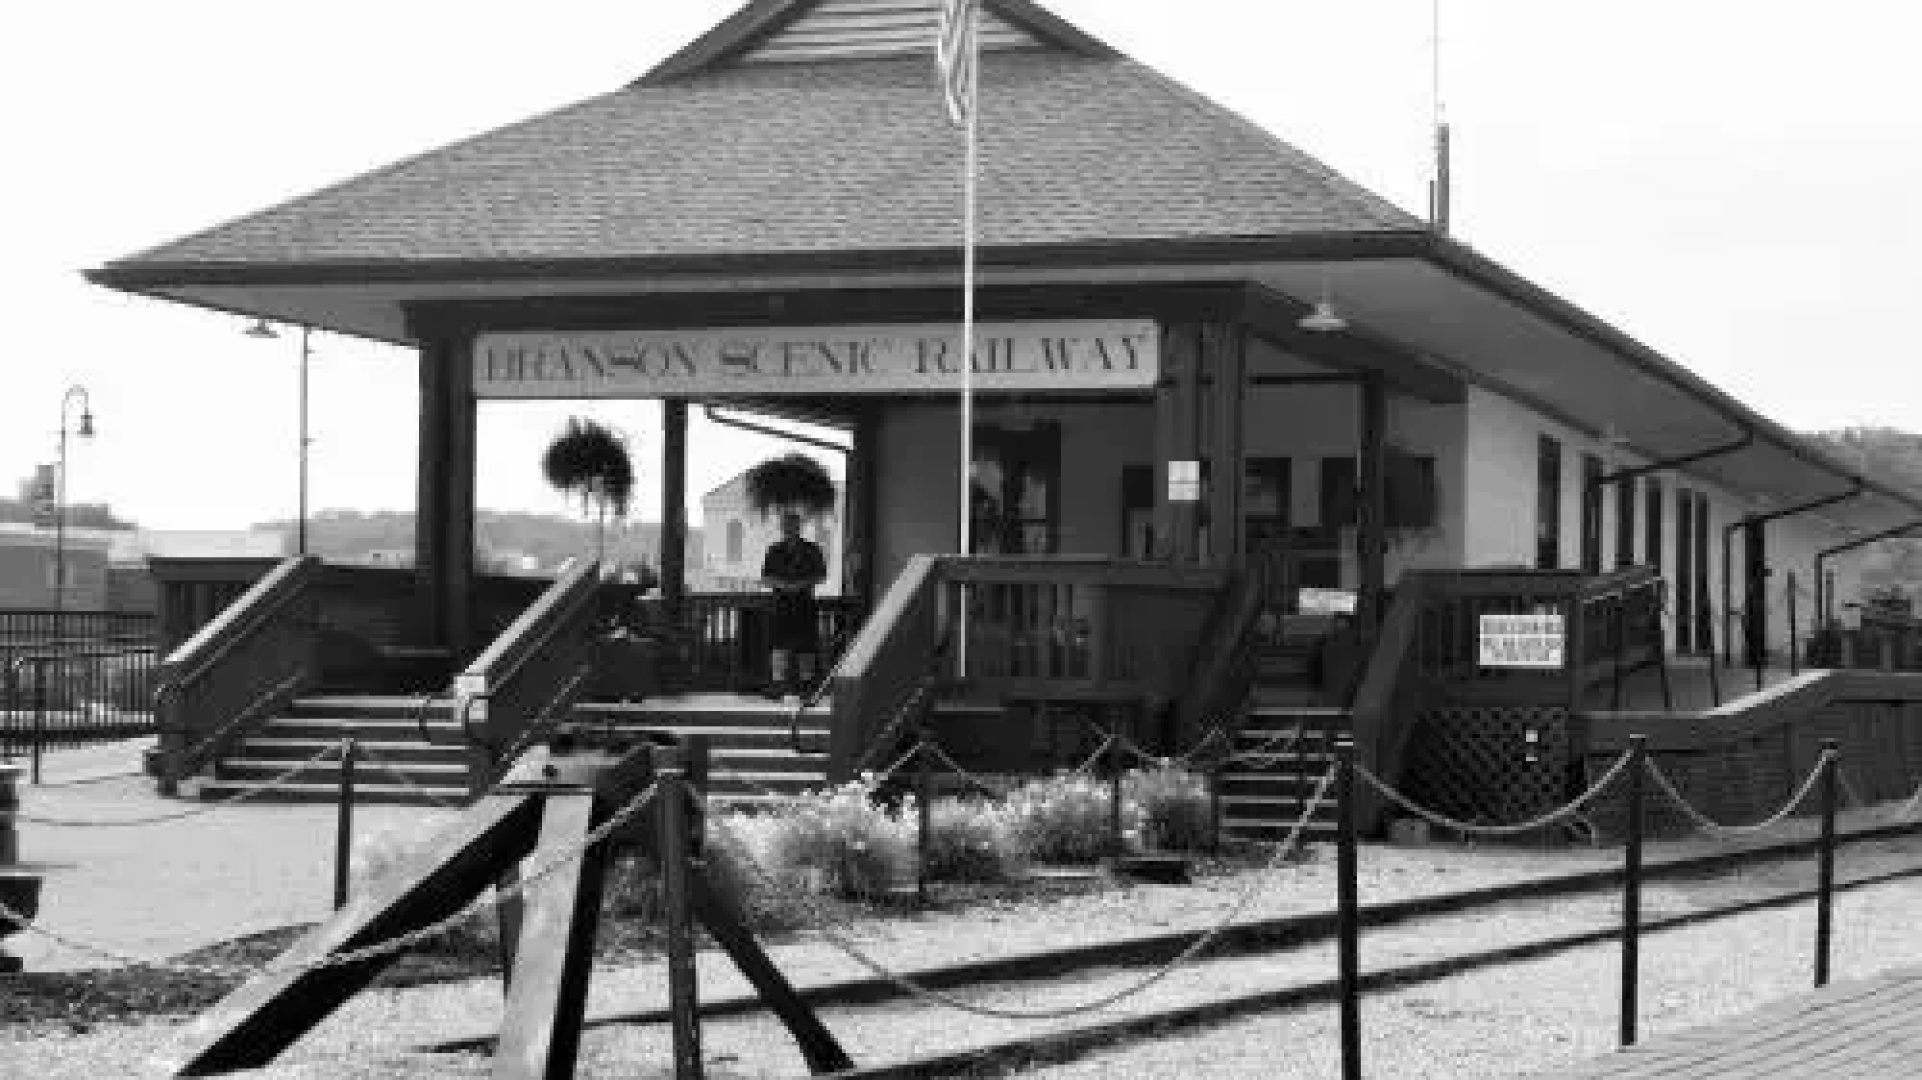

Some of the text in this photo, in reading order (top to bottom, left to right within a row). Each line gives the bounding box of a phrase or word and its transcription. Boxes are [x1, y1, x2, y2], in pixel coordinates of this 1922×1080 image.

[486, 334, 1146, 382] BRANSON SCENIC RAILWAY
